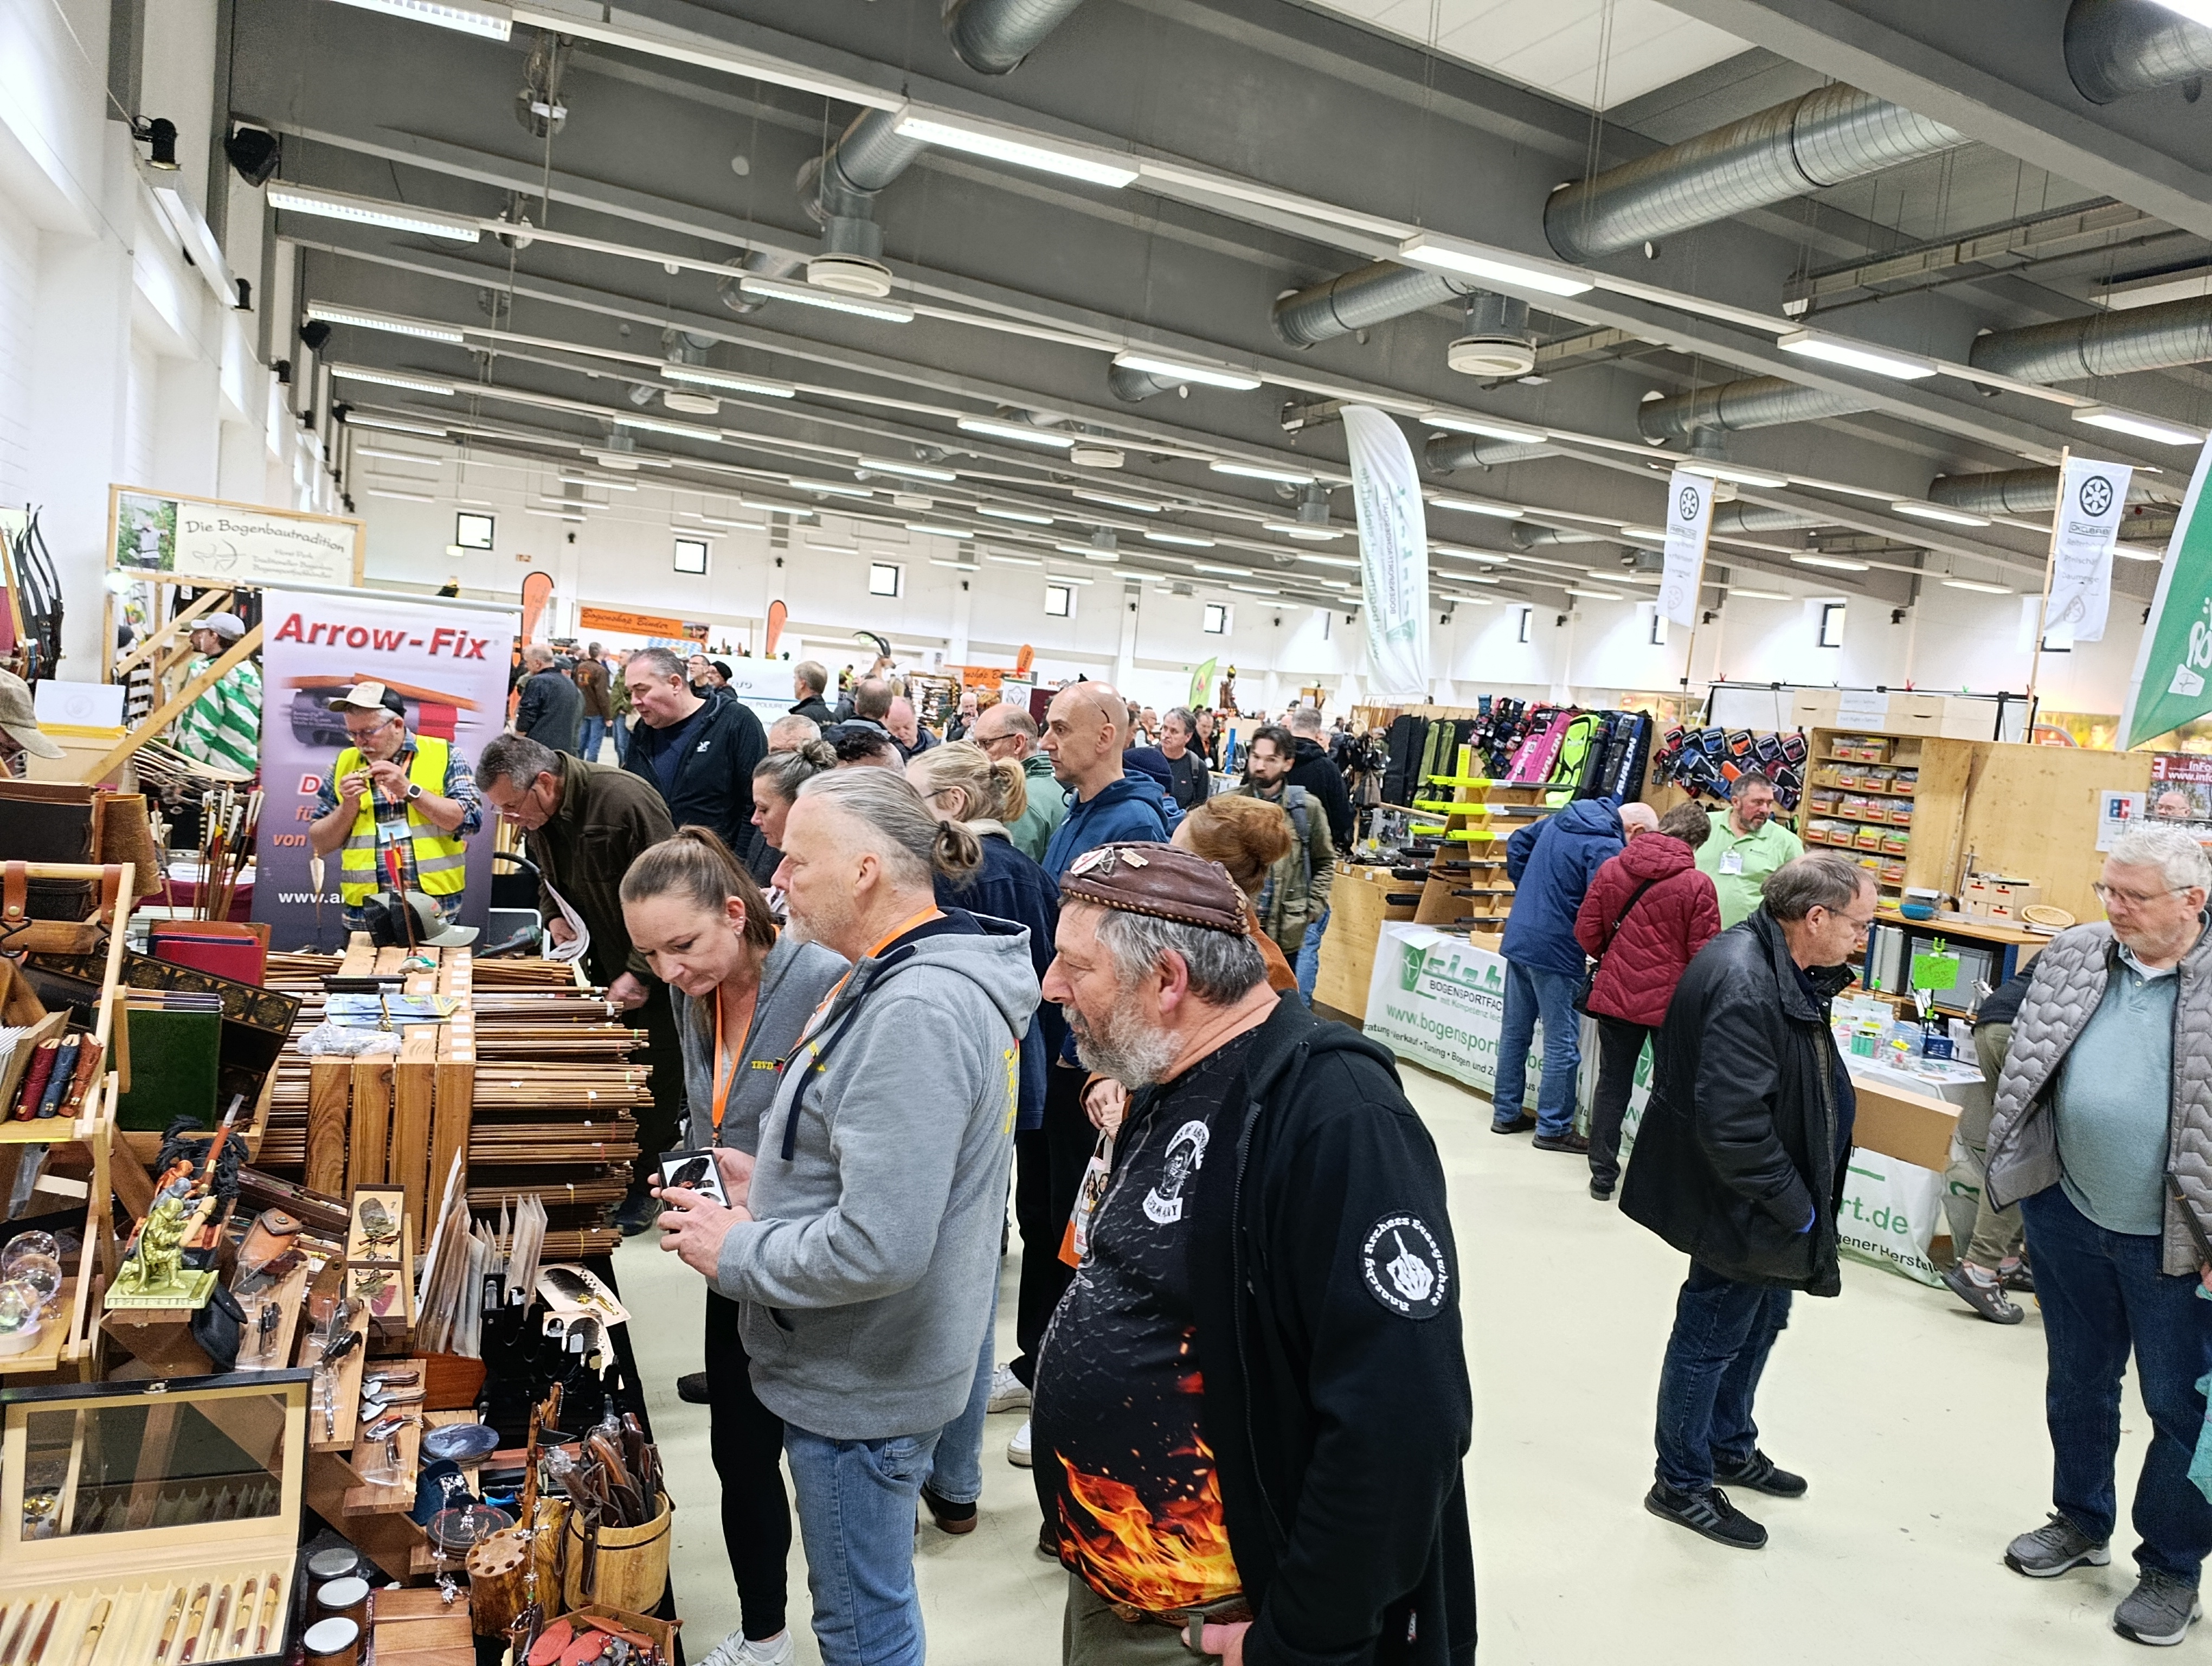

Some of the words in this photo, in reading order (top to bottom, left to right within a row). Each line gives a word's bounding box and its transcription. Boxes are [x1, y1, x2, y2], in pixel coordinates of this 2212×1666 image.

[185, 520, 214, 534] Die
[218, 519, 345, 554] Bogenbautradition
[1616, 736, 1637, 796] AVALON
[273, 834, 306, 847] von
[1429, 979, 1502, 1011] BOGENSPORTFAC
[1423, 1041, 1446, 1059] Tuning
[1451, 1052, 1471, 1067] Bogen
[1472, 1060, 1487, 1073] und
